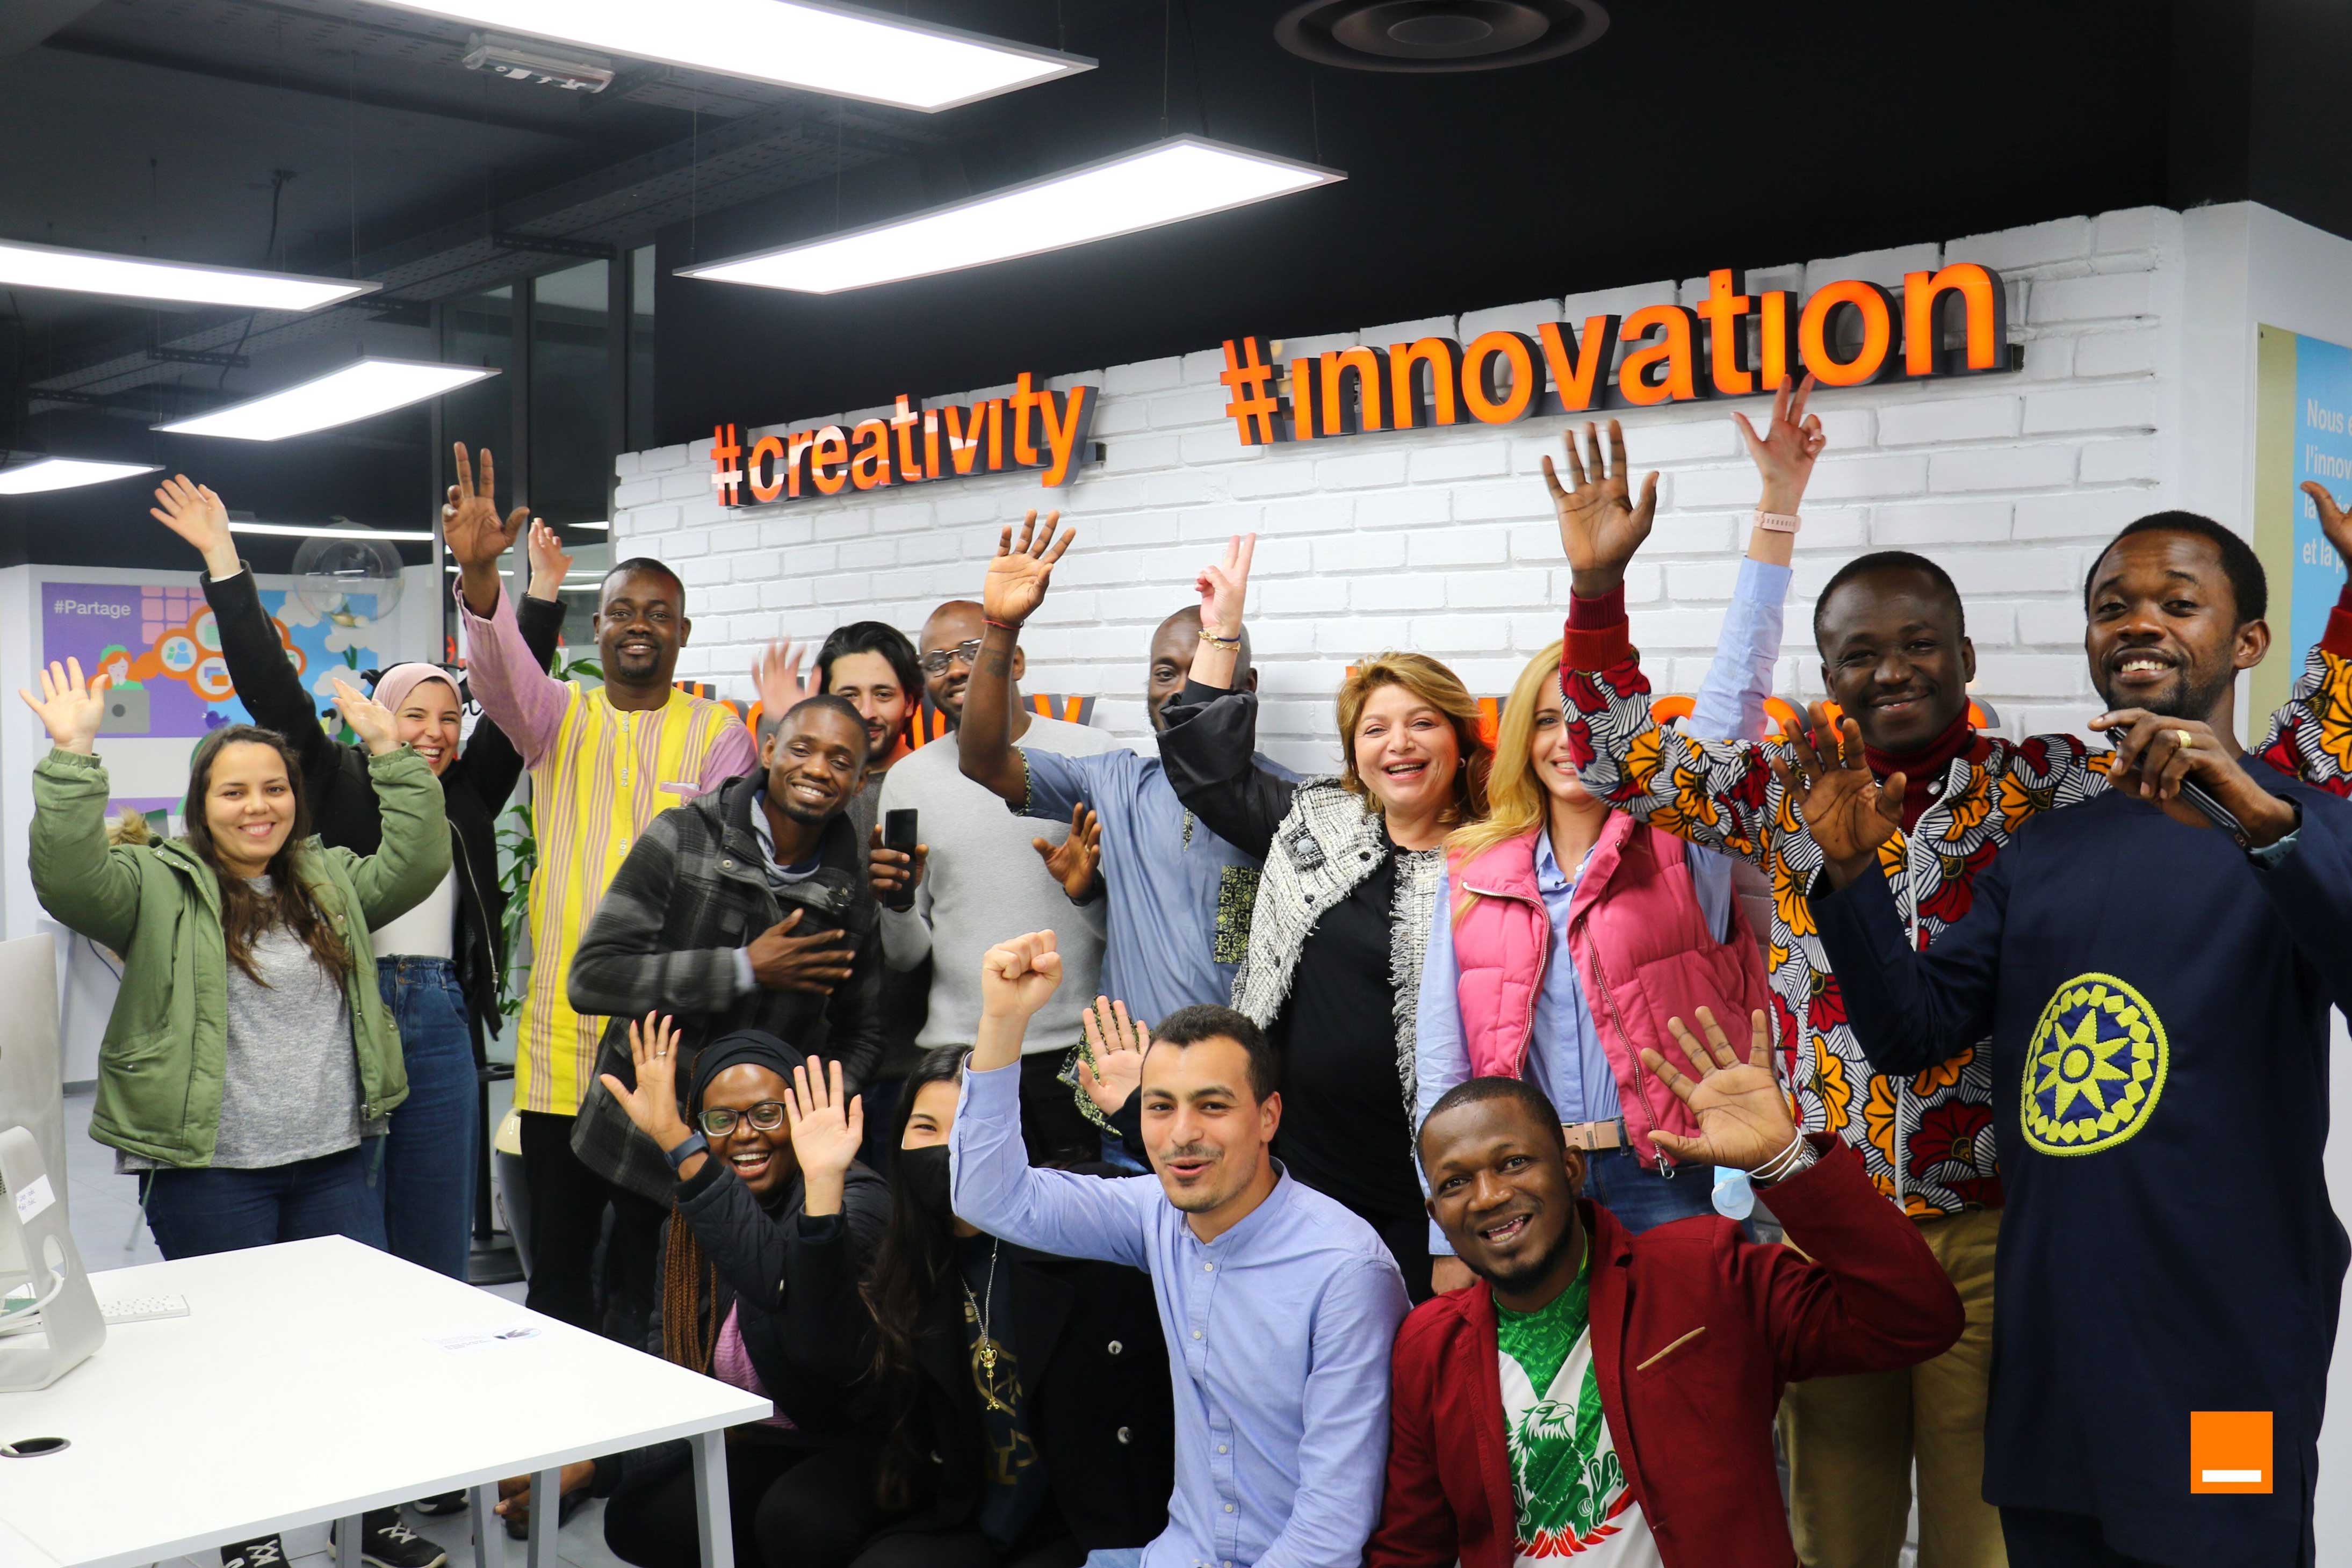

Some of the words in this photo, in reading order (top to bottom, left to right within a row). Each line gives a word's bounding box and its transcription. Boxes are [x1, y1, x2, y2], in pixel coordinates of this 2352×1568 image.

[1220, 262, 1996, 446] #innovation
[2306, 398, 2344, 434] Nous
[710, 372, 1091, 507] #creativity
[2303, 538, 2317, 565] et
[2320, 537, 2332, 567] la
[54, 599, 131, 618] #Partage
